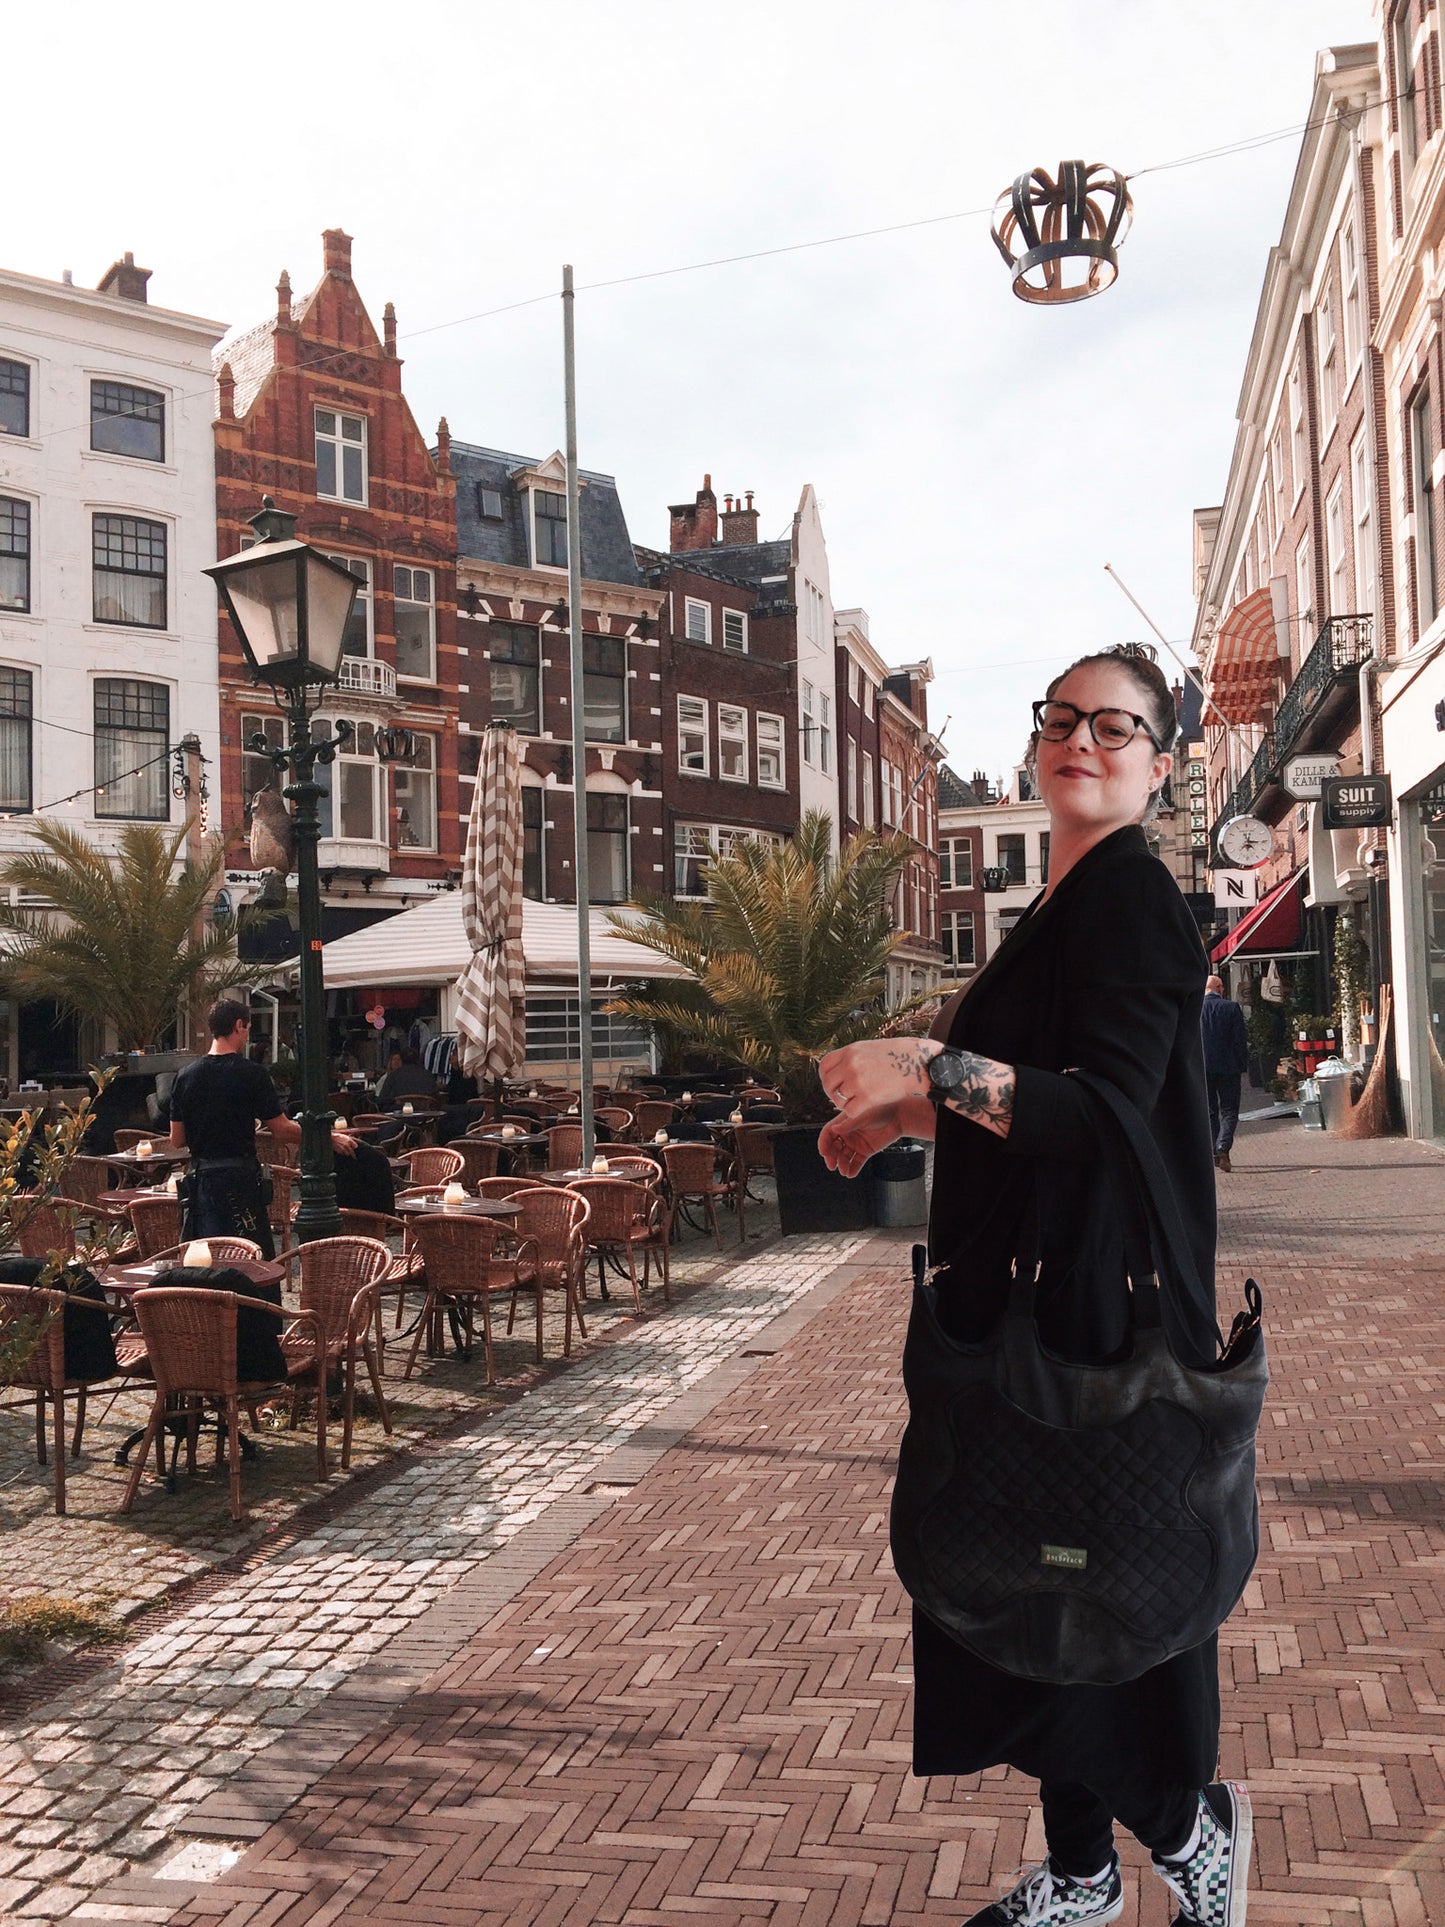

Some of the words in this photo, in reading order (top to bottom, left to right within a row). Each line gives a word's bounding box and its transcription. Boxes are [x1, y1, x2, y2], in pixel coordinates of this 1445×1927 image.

[1295, 765, 1325, 776] DILLE
[1328, 766, 1337, 775] &
[1338, 787, 1375, 803] SUIT
[1191, 765, 1205, 846] ROLEX
[1339, 807, 1376, 817] supply
[1222, 876, 1249, 899] N
